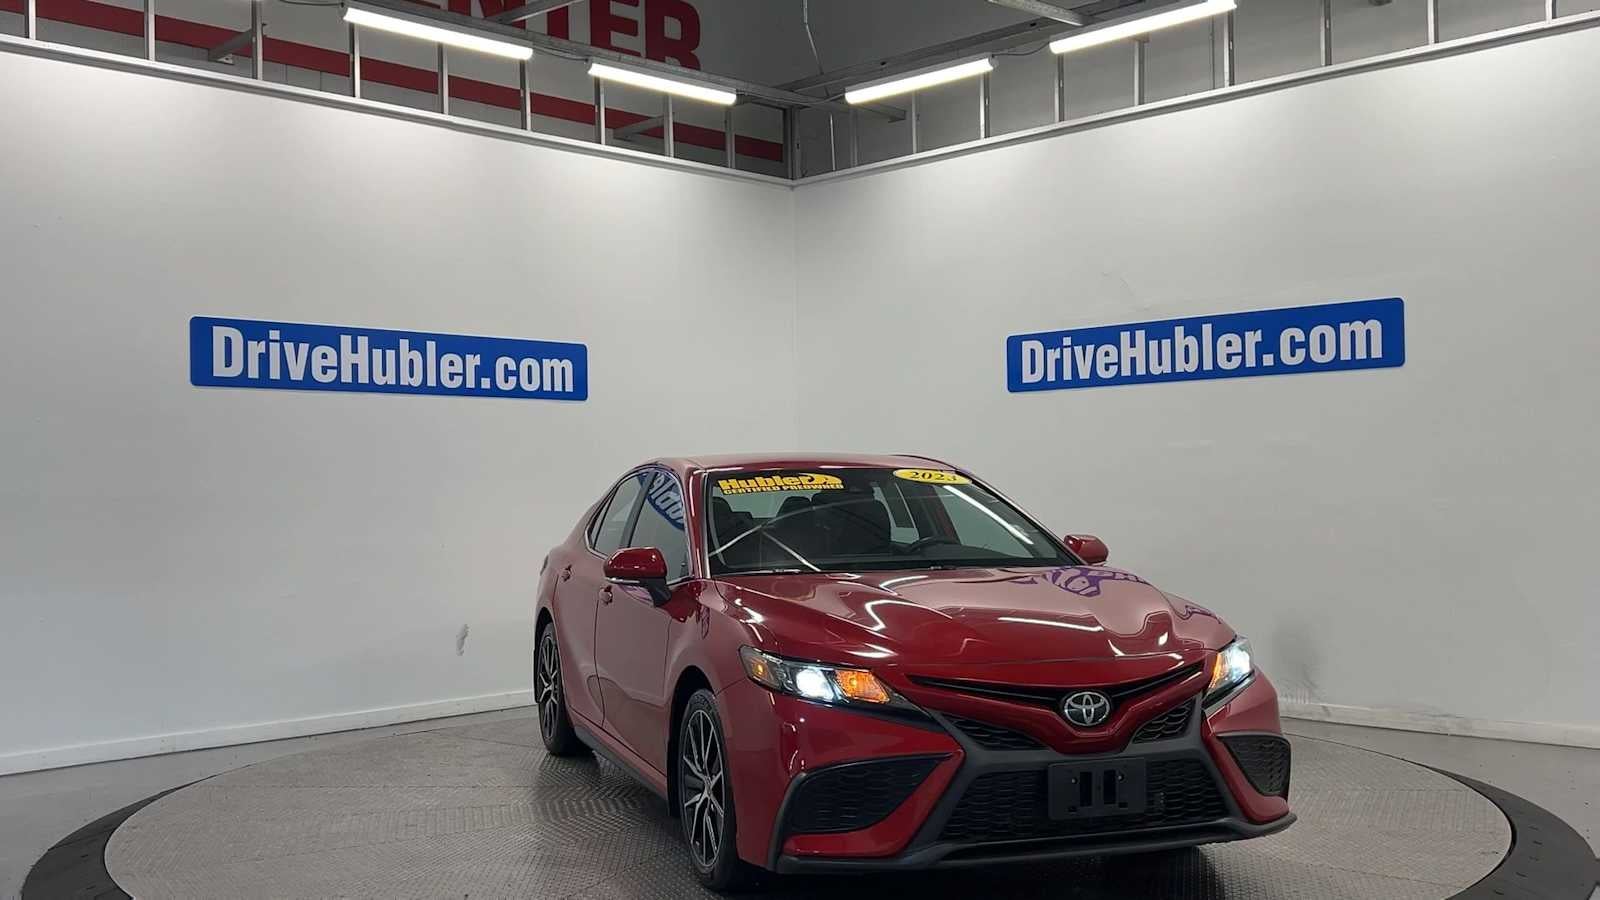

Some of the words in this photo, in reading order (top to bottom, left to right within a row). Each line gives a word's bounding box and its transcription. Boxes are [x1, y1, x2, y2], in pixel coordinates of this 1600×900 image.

[212, 325, 575, 393] DriveHubler.com
[1020, 318, 1384, 384] DriveHubler.com
[718, 475, 815, 490] Hubler
[910, 471, 957, 481] 2023
